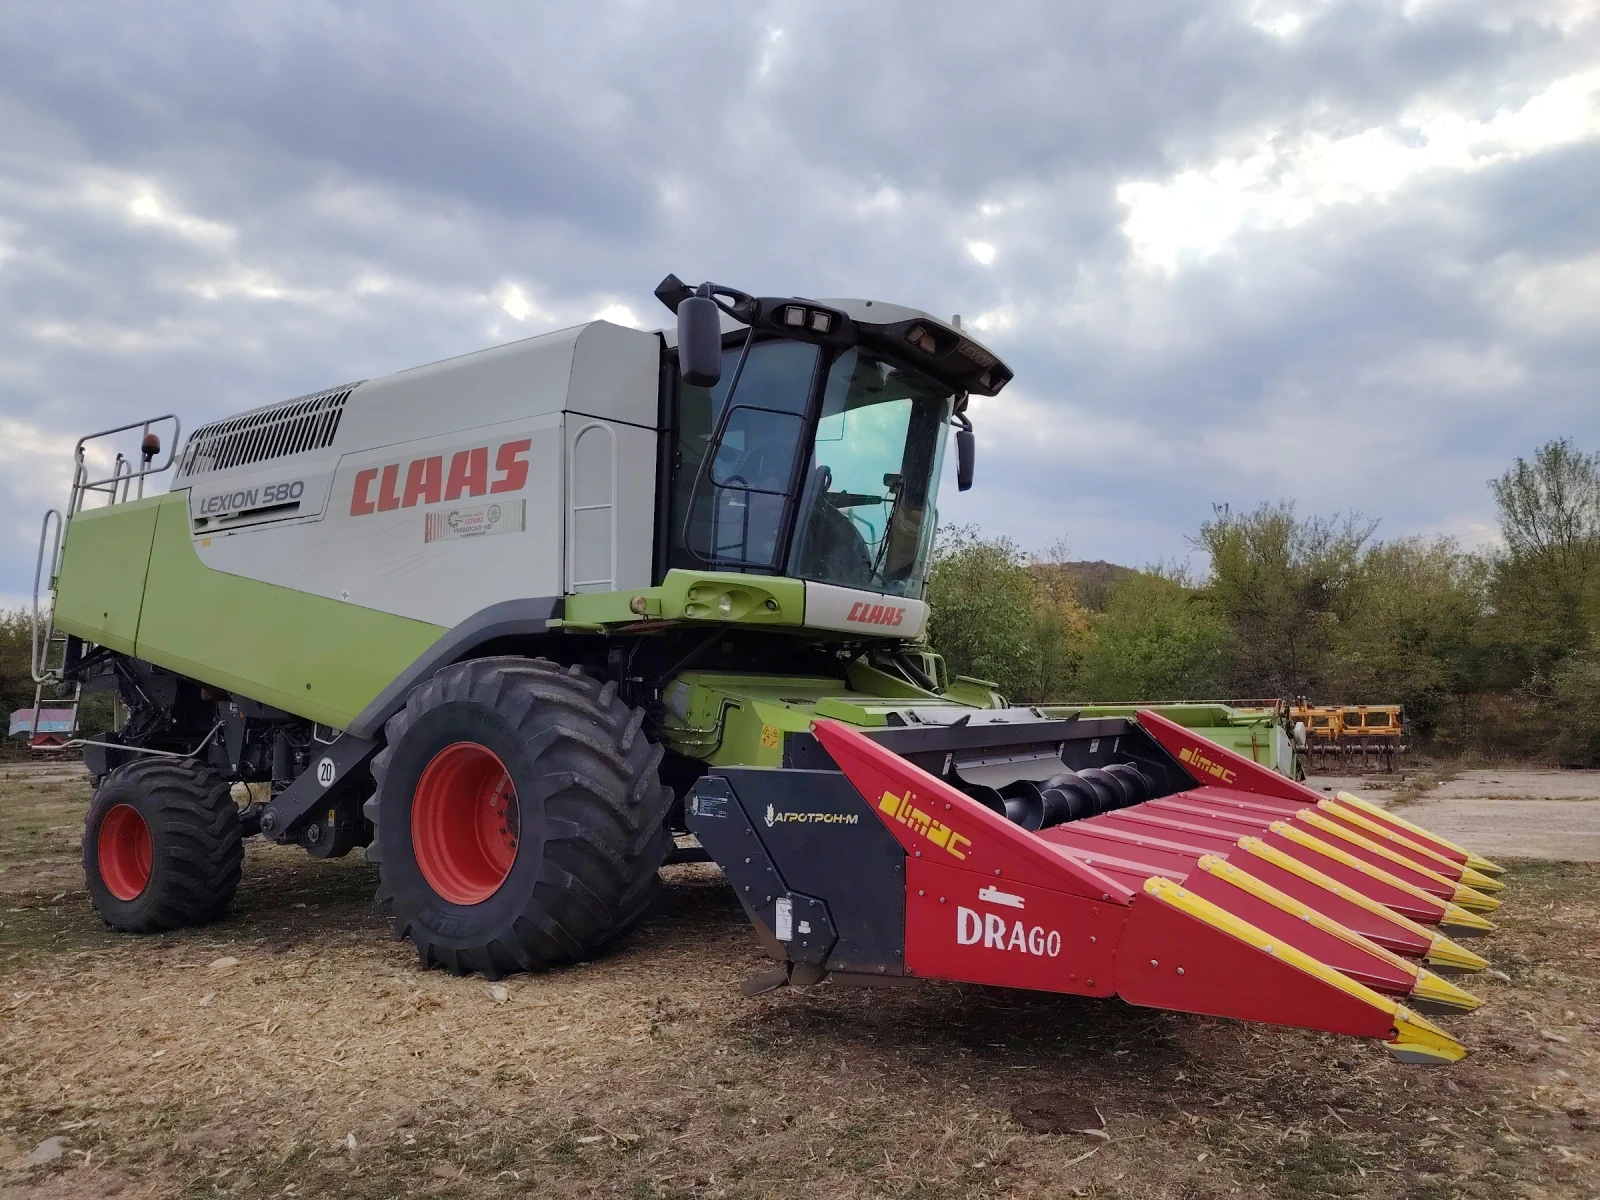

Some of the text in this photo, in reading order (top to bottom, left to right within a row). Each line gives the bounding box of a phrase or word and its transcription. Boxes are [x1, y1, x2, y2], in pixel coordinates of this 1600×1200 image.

[350, 438, 532, 516] CLAAS
[200, 481, 305, 515] LEXION 580
[847, 602, 906, 627] CLAAS
[321, 763, 331, 781] 20
[956, 905, 1062, 958] DRAGO
